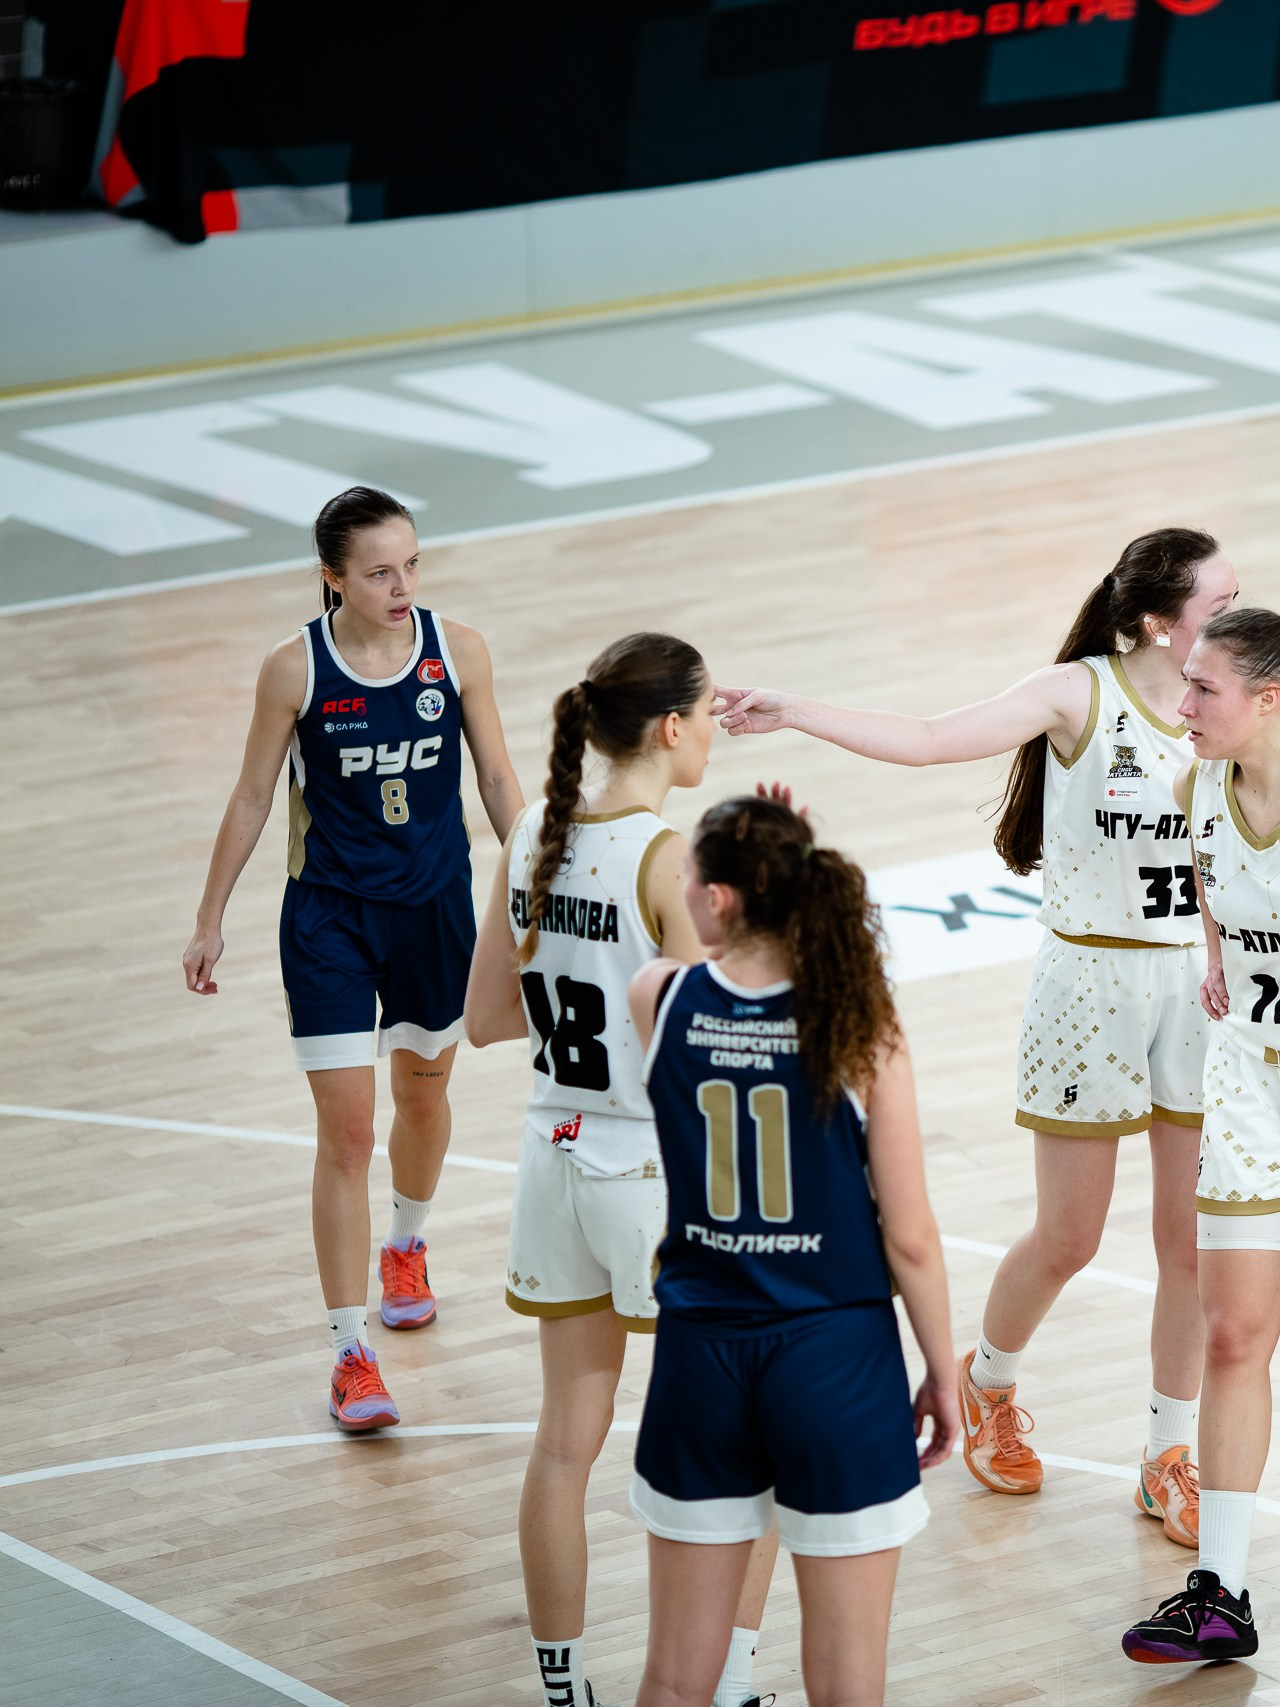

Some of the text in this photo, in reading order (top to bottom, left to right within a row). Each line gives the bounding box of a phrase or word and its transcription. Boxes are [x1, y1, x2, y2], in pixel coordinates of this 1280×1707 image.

[853, 0, 1137, 50] БУДЬ В ИГРЕ
[349, 721, 369, 730] РЖД
[339, 735, 443, 777] РУС
[381, 778, 410, 825] 8
[1138, 864, 1200, 919] 33
[686, 1028, 800, 1054] УНИВЕРСИТЕТ
[692, 1012, 798, 1036] РОССИЙСКИЙ
[710, 1049, 774, 1071] СПОРТА
[697, 1079, 794, 1223] 11
[685, 1223, 823, 1254] ГЦОЛИФК
